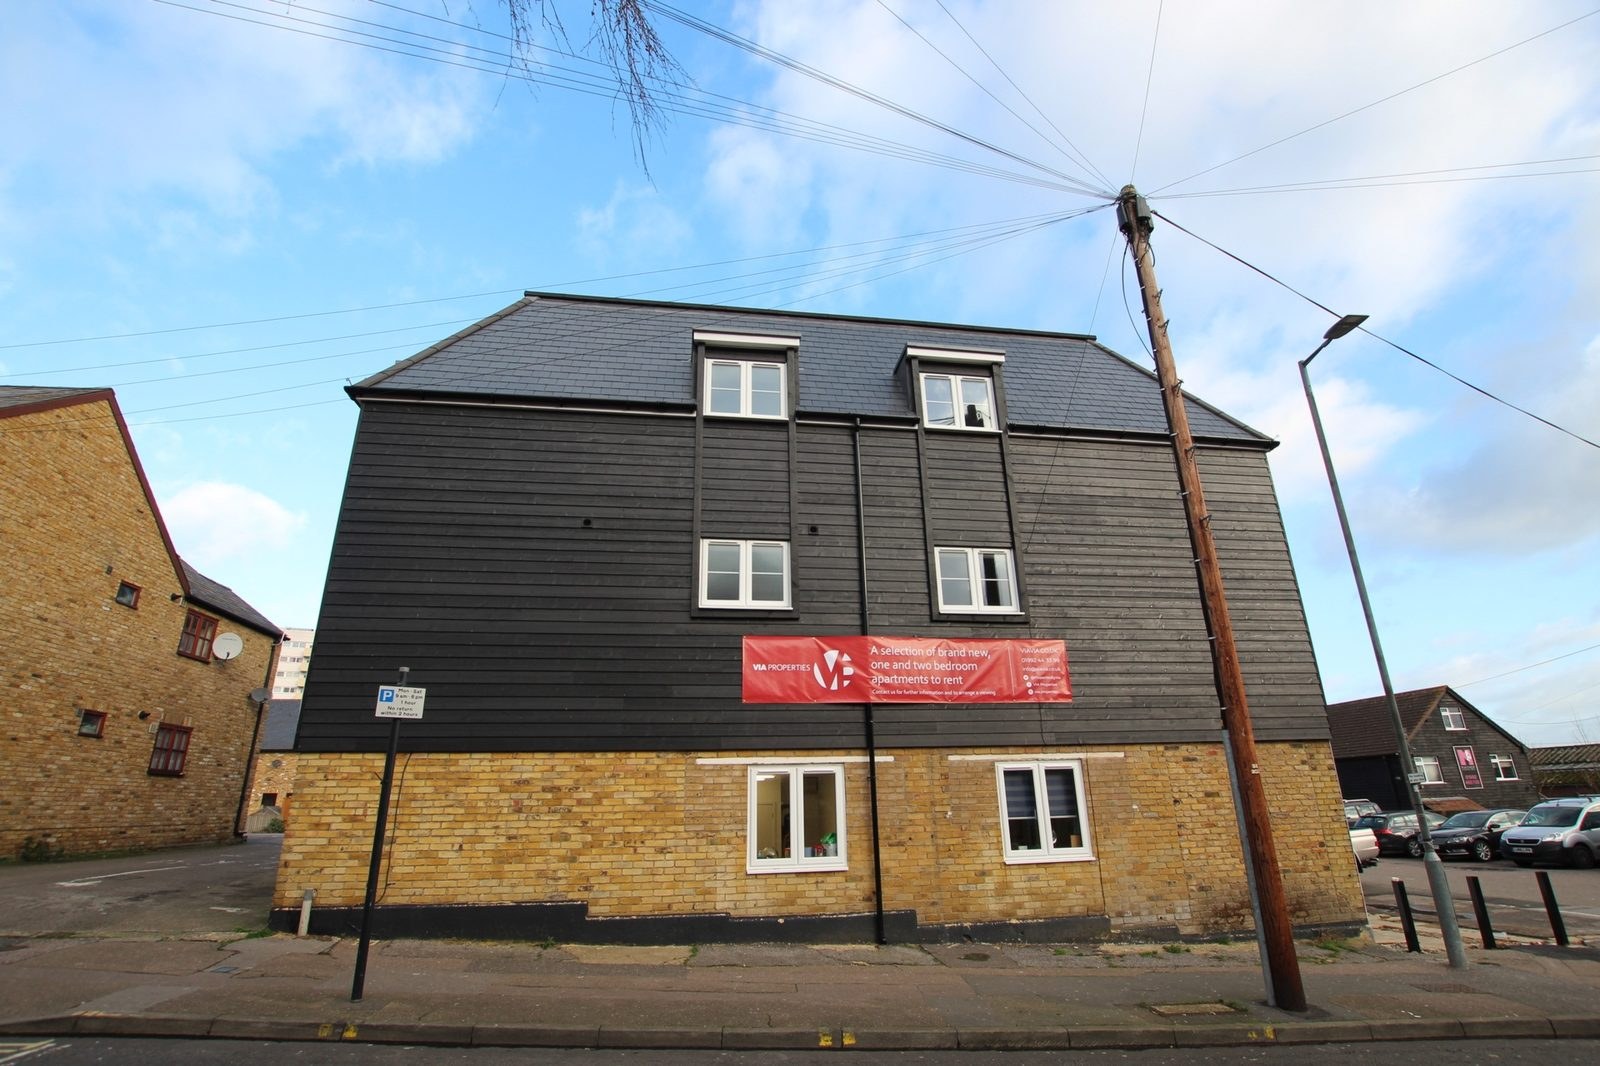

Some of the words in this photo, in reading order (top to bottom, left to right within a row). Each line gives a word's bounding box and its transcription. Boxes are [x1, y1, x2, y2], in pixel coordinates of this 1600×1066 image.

[870, 645, 879, 655] A
[880, 645, 924, 656] selection
[926, 646, 936, 656] of
[938, 647, 966, 657] brand
[968, 649, 991, 659] new,
[752, 663, 767, 671] VIA
[767, 663, 811, 672] PROPERTIES
[870, 661, 890, 669] one
[892, 660, 911, 670] and
[913, 661, 932, 670] two
[934, 661, 978, 671] bedroom
[871, 675, 929, 687] apartments
[931, 676, 941, 685] to
[943, 676, 964, 685] rent
[382, 690, 393, 701] P
